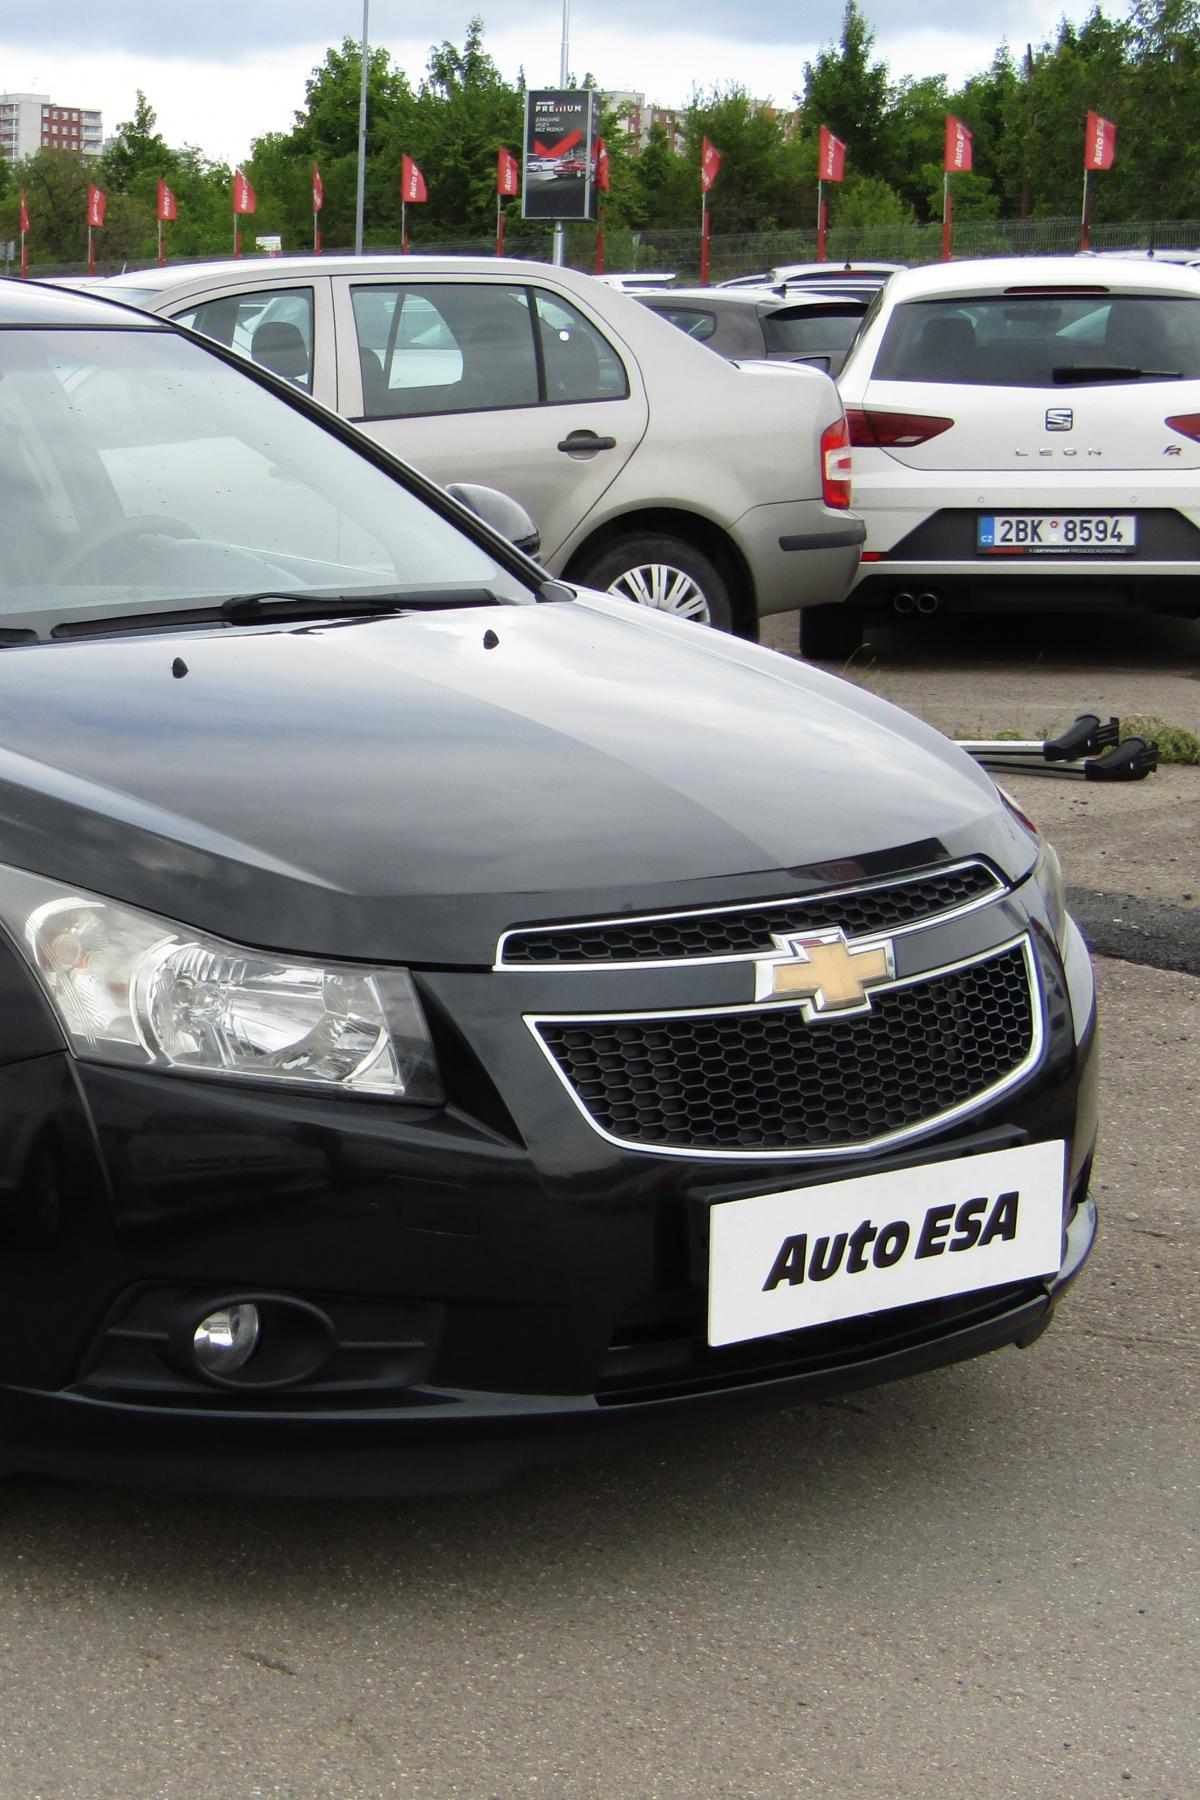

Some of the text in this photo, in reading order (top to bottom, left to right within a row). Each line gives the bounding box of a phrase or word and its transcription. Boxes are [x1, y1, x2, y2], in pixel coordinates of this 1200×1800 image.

[954, 140, 965, 167] Auto
[1093, 138, 1104, 165] Auto
[410, 176, 418, 198] Auto
[1015, 447, 1102, 457] LEON
[981, 519, 1123, 543] CZ 2BK 8594
[762, 1191, 1019, 1292] Auto ESA
